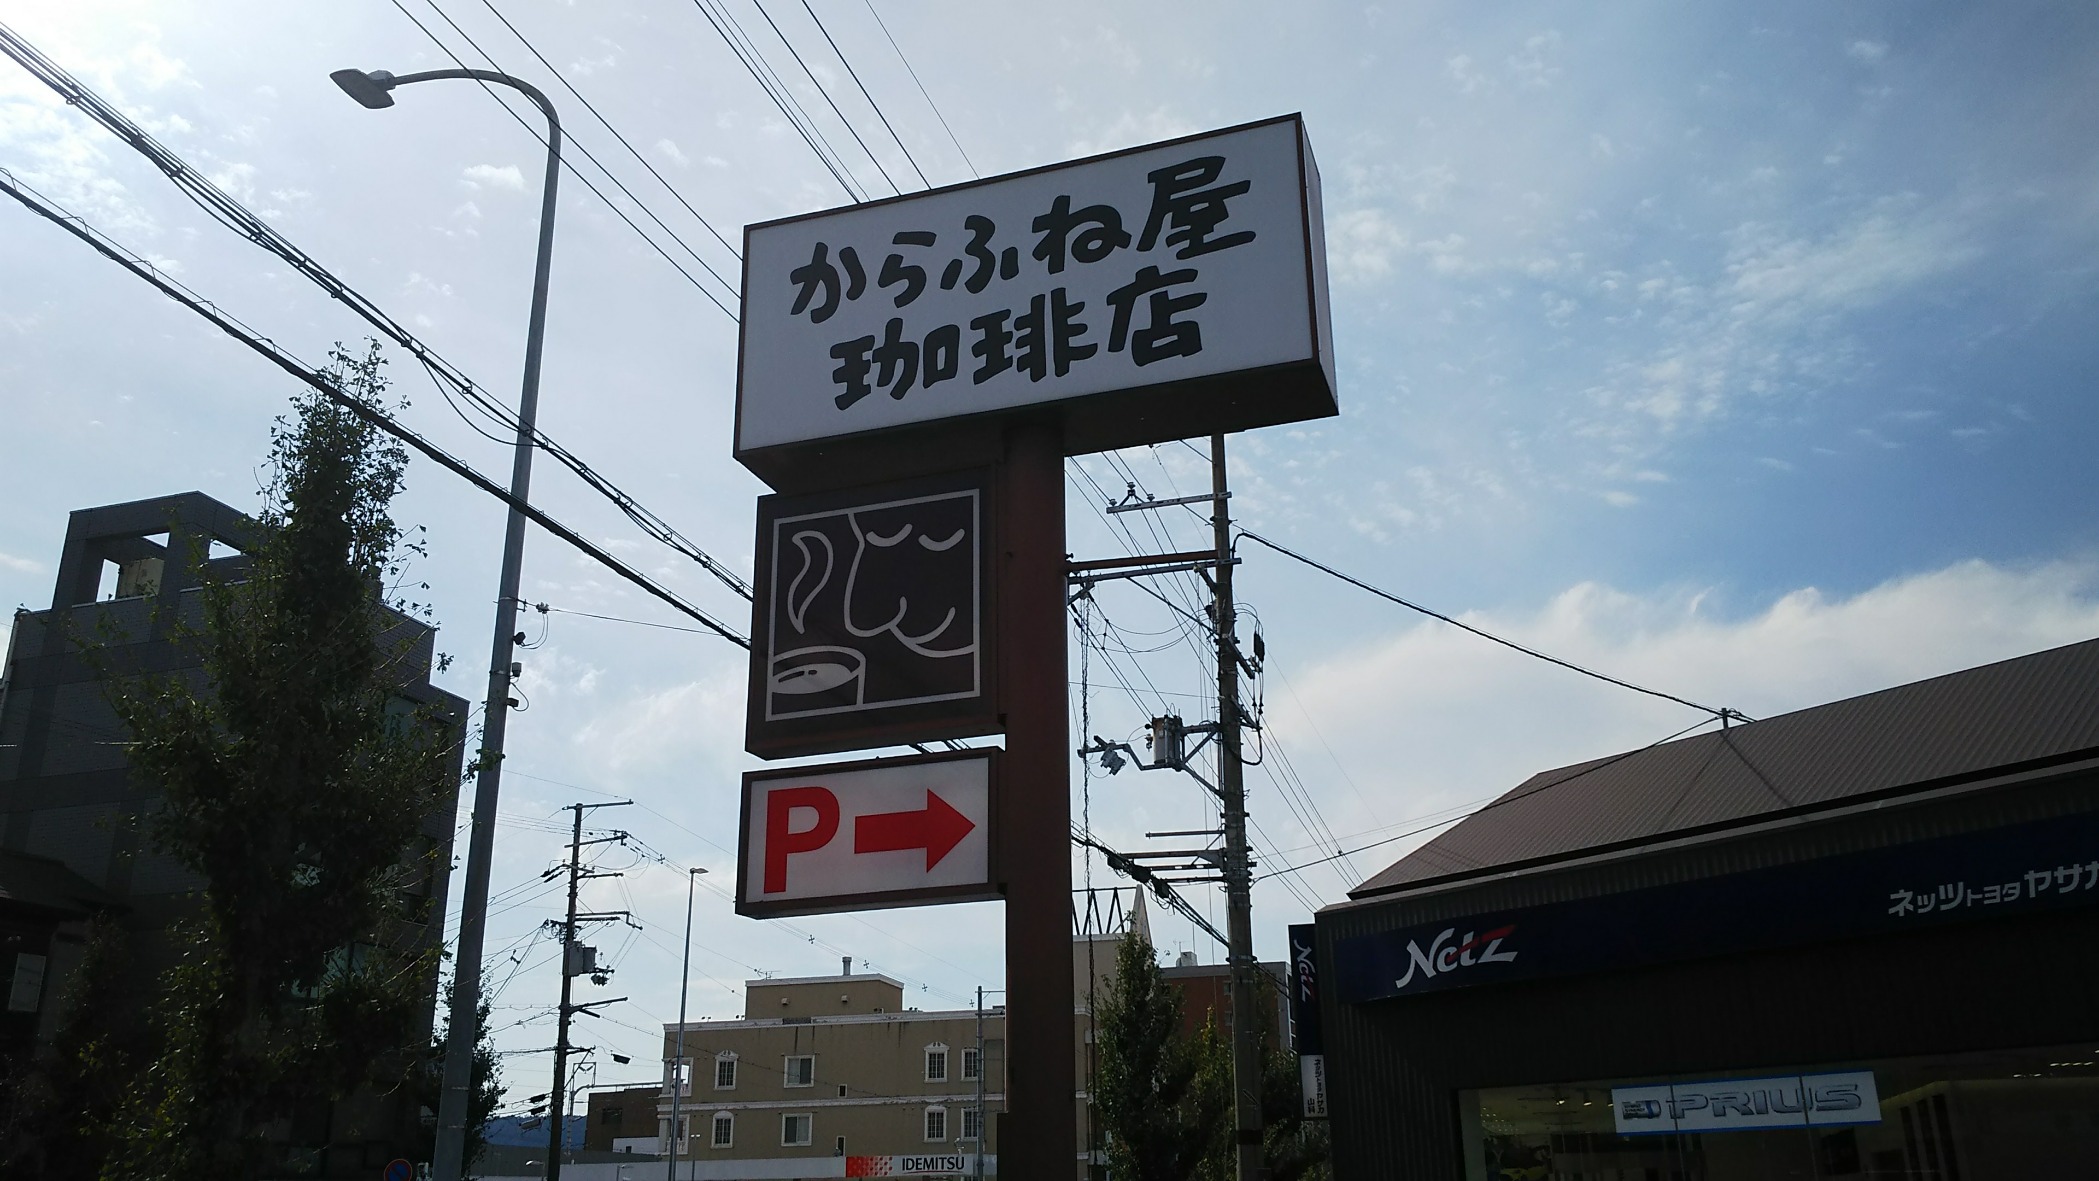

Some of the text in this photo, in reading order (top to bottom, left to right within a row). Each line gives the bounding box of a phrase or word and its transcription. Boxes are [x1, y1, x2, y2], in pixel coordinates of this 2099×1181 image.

[790, 156, 1257, 323] からふね屋
[829, 265, 1208, 410] 珈琲店
[763, 786, 840, 894] P
[1665, 1083, 1862, 1119] PRIUS
[902, 1156, 965, 1171] IDEMITSU
